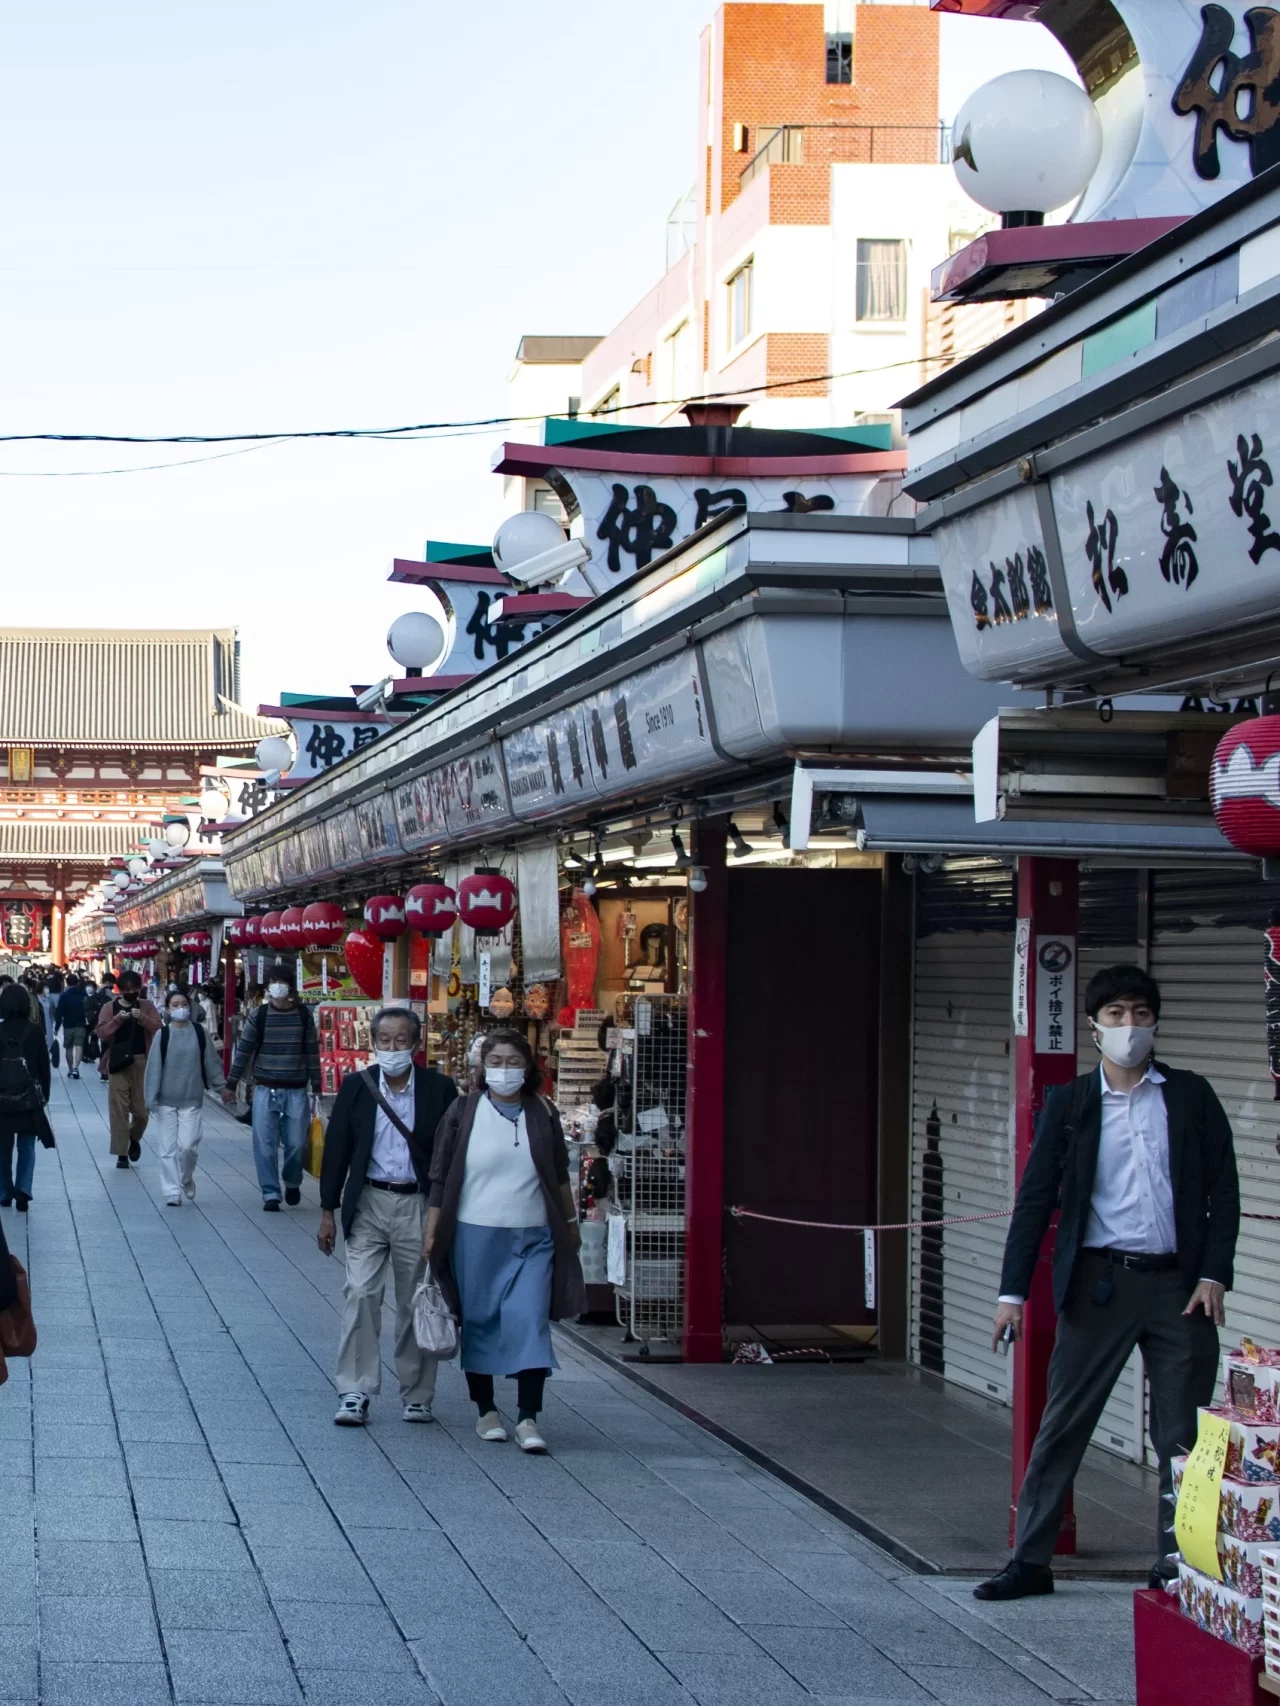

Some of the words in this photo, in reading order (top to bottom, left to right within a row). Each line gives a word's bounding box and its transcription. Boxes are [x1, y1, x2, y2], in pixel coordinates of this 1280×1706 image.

[645, 711, 661, 735] Since
[659, 703, 674, 729] 1910
[1048, 974, 1064, 1051] ポイ捨て禁止
